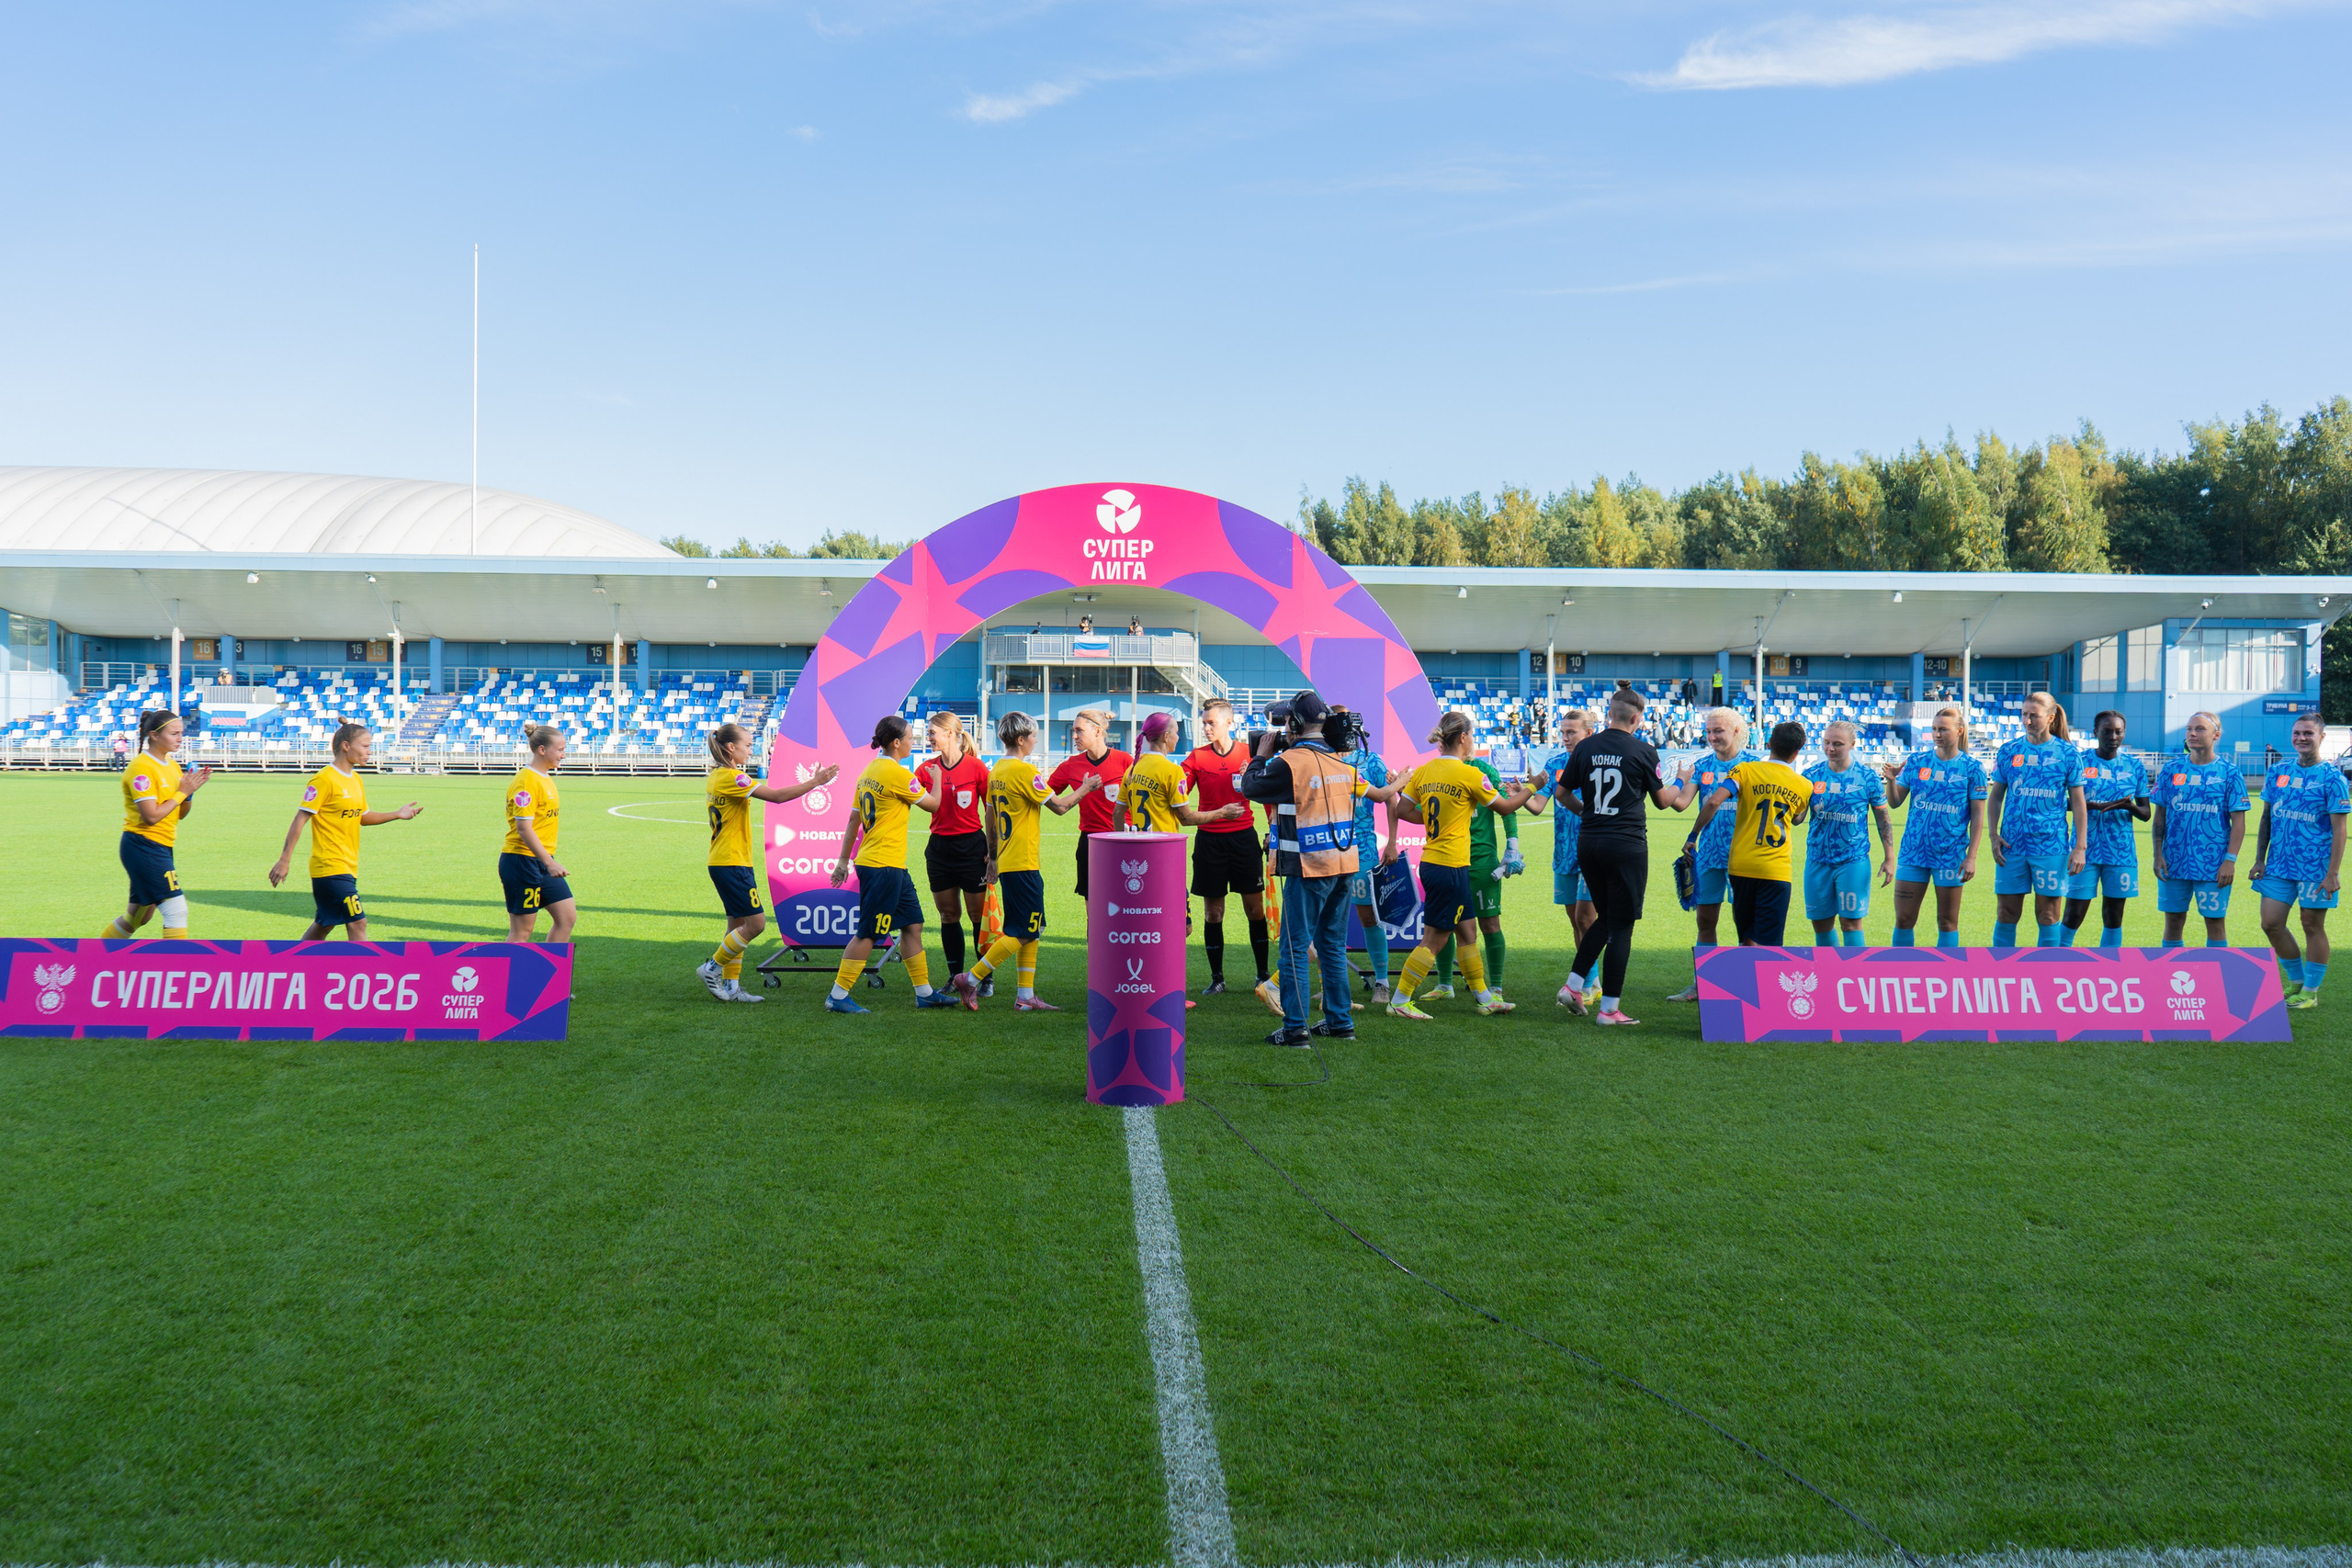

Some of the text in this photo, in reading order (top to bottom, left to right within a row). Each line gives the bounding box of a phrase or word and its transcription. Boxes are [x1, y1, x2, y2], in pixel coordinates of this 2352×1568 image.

[1083, 538, 1154, 558] СУПЕР
[1091, 561, 1147, 580] ЛИГА
[197, 642, 211, 654] 16
[351, 644, 363, 654] 16
[370, 643, 384, 656] 15
[591, 646, 603, 658] 15
[1532, 655, 1543, 666] 12
[1569, 656, 1582, 667] 10
[1772, 658, 1787, 671] 10
[1795, 658, 1803, 669] 9
[1924, 659, 1947, 671] 12-10
[1591, 755, 1623, 767] КОНАК
[1589, 768, 1623, 816] 12
[1753, 784, 1801, 806] КОСТАРЕВА
[2021, 787, 2056, 799] ГАЗПРОМ
[1925, 802, 1959, 814] ГАЗПРОМ
[2183, 803, 2218, 814] ГАЗПРОМ
[1427, 796, 1441, 840] 8
[1756, 799, 1790, 848] 13
[1824, 811, 1857, 823] ГАЗПРОМ
[2281, 811, 2316, 823] ГАЗПРОМ
[799, 831, 859, 840] НОВАТ
[1396, 836, 1427, 846] НОВА
[2035, 870, 2058, 891] 55
[2120, 873, 2130, 892] 9
[523, 887, 541, 909] 26
[749, 887, 761, 908] 8
[2298, 882, 2318, 902] 24
[343, 894, 363, 917] 16
[1476, 890, 1484, 910] 1
[1838, 891, 1857, 911] 10
[2198, 891, 2220, 911] 23
[1454, 905, 1464, 925] 8
[875, 913, 892, 935] 19
[91, 970, 306, 1010] СУПЕРЛИГА
[324, 972, 420, 1011] 2026
[1837, 977, 2042, 1013] СУПЕРЛИГА
[2053, 977, 2145, 1013] 2026
[442, 995, 485, 1007] СУПЕР
[2167, 998, 2206, 1009] СУПЕР
[445, 1008, 479, 1020] ЛИГА
[2174, 1010, 2205, 1021] ЛИГА
